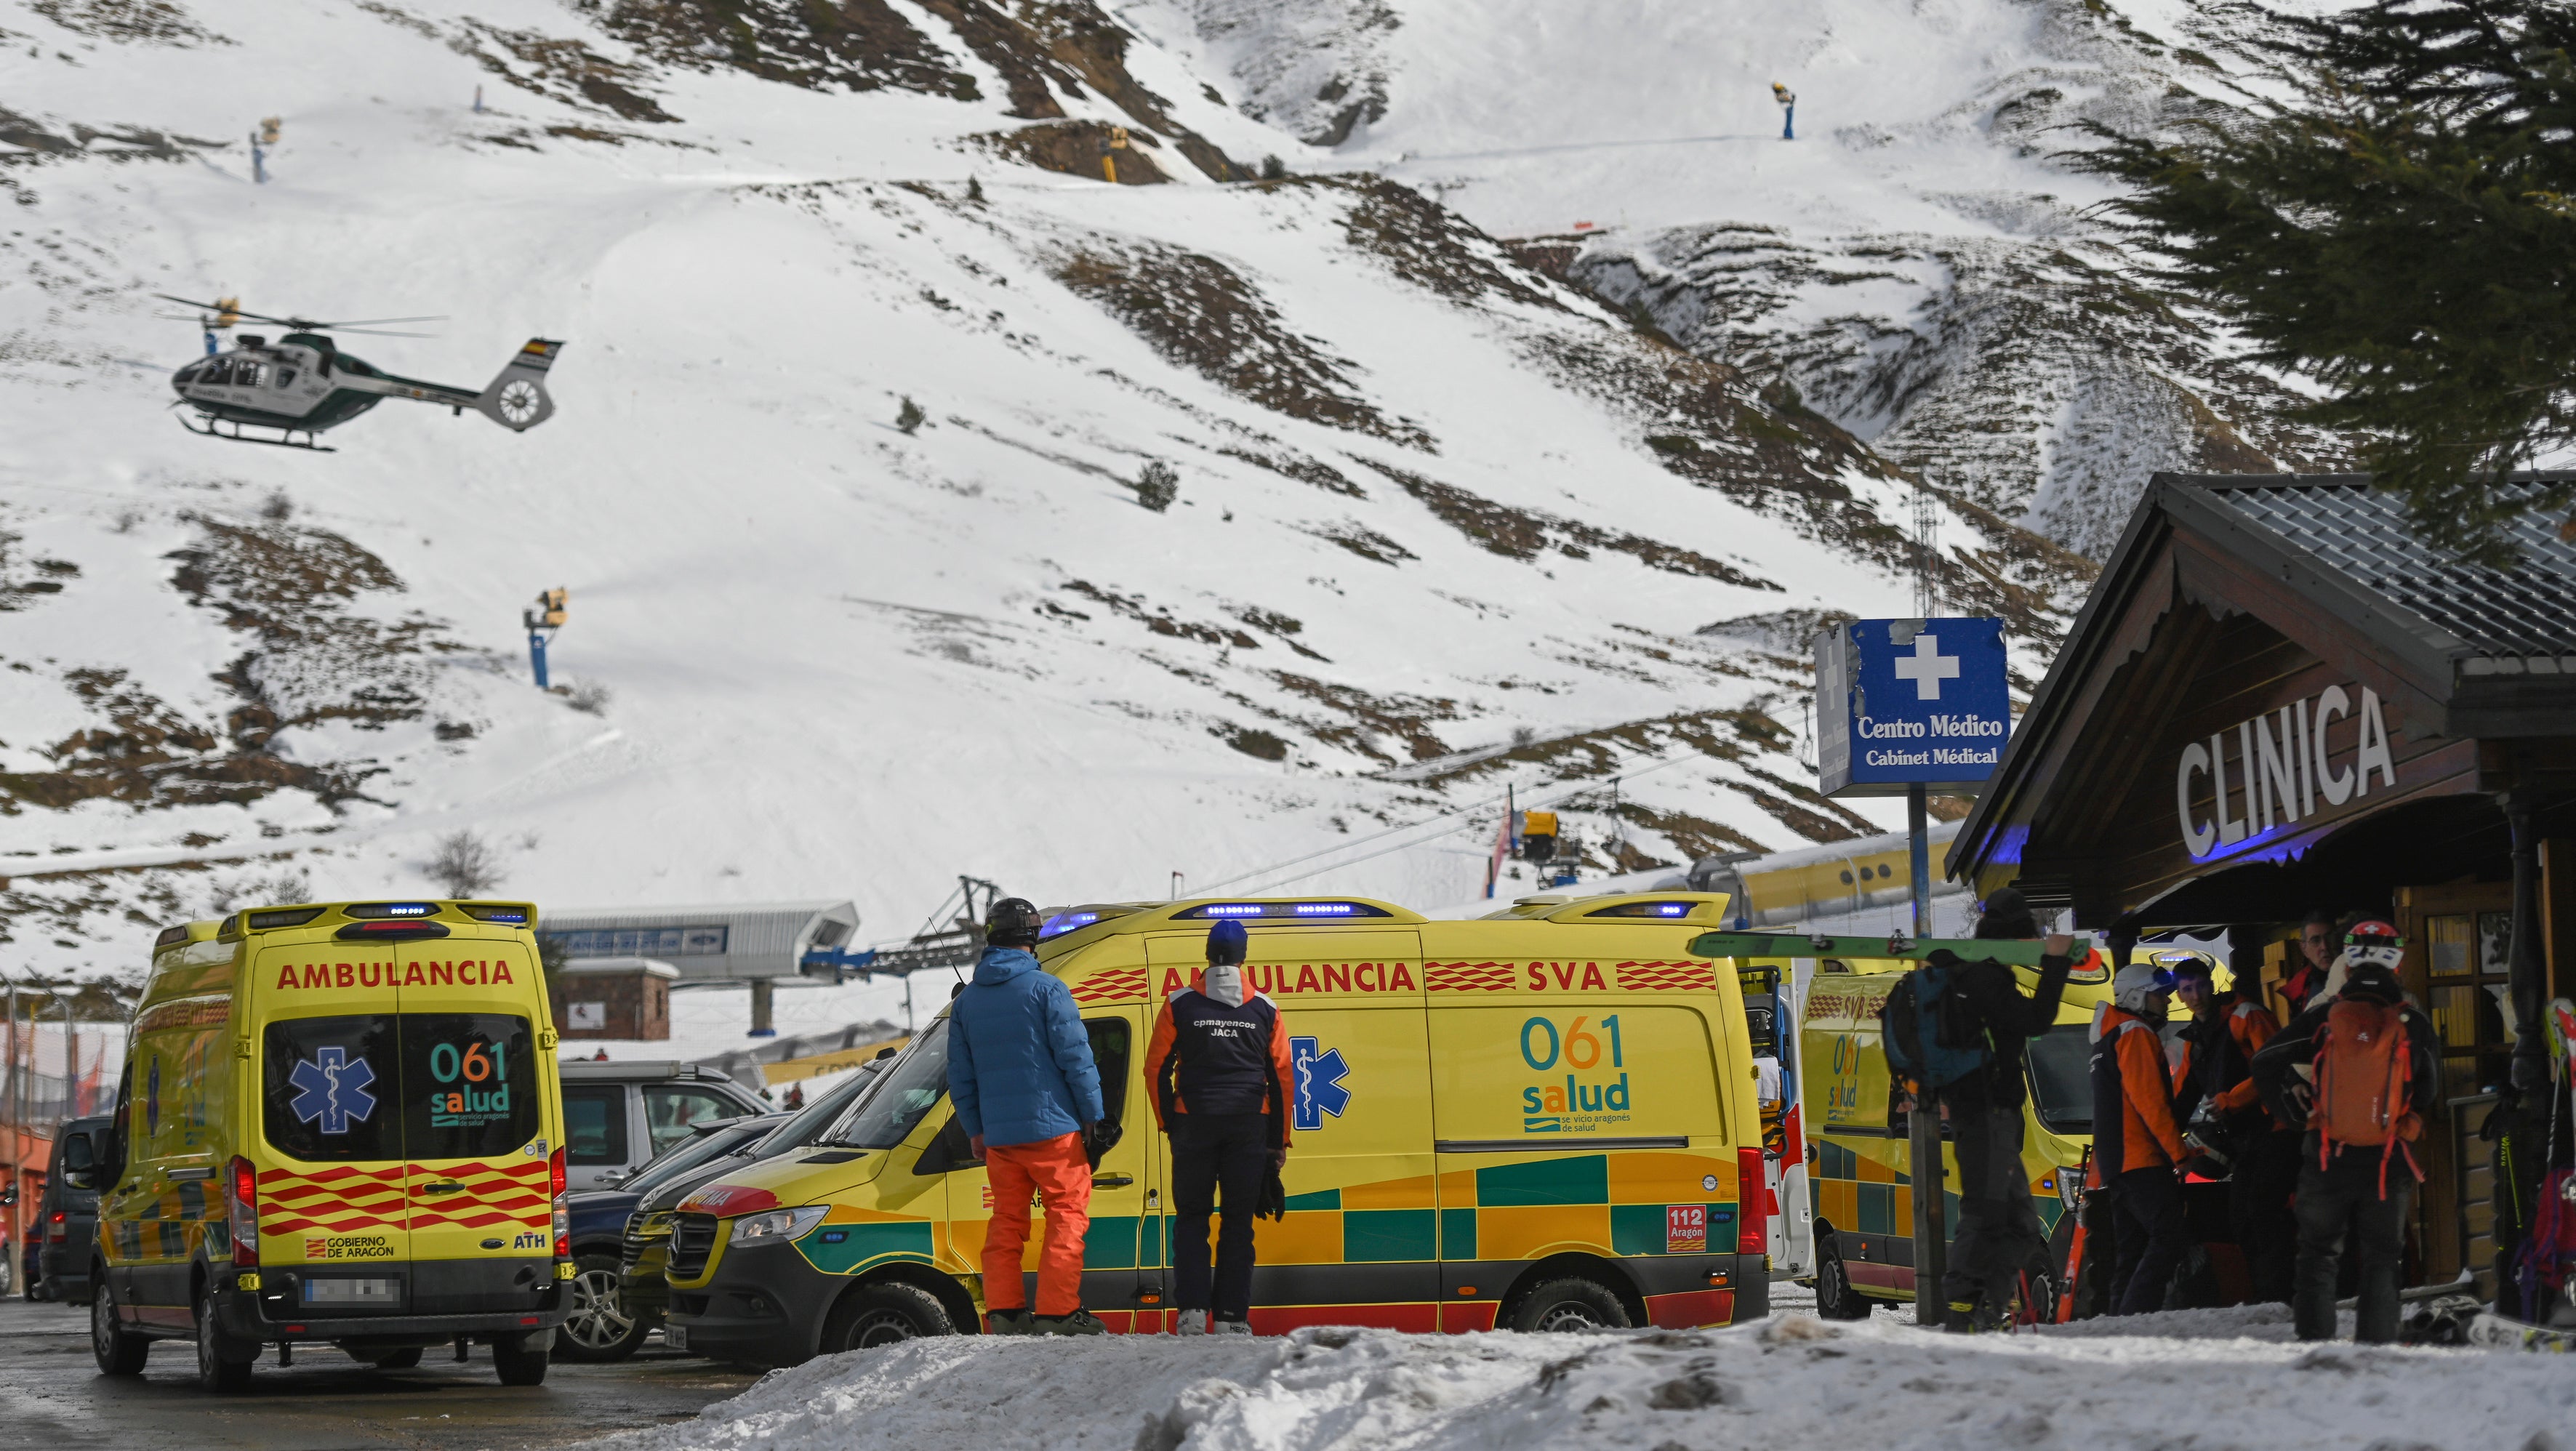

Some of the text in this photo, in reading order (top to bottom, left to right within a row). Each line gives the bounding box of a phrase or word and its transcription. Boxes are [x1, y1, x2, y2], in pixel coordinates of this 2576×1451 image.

[1858, 715, 2002, 739] Centro Médico
[1866, 748, 1998, 766] Cabinet Médical
[2178, 686, 2396, 857] CLINICA
[276, 960, 513, 989] AMBULANCIA
[1160, 962, 1416, 997] AULANCIA
[1528, 962, 1607, 991] SVA
[1842, 996, 1865, 1019] SVB
[1193, 1018, 1256, 1029] cpmayencos
[1211, 1029, 1239, 1037] JACA
[1520, 1015, 1622, 1071] 061
[1834, 1034, 1862, 1075] 061
[430, 1042, 505, 1082] 061
[431, 1083, 509, 1113] salud
[1523, 1073, 1630, 1114] salud
[1829, 1079, 1857, 1108] salud
[483, 1112, 510, 1121] aragonés
[1594, 1113, 1630, 1124] aragonés
[1671, 1209, 1702, 1226] 112
[327, 1237, 385, 1247] GOBIERNO
[513, 1233, 545, 1250] ATH
[1671, 1226, 1702, 1239] Aragón
[328, 1247, 394, 1258] DE ARAGON
